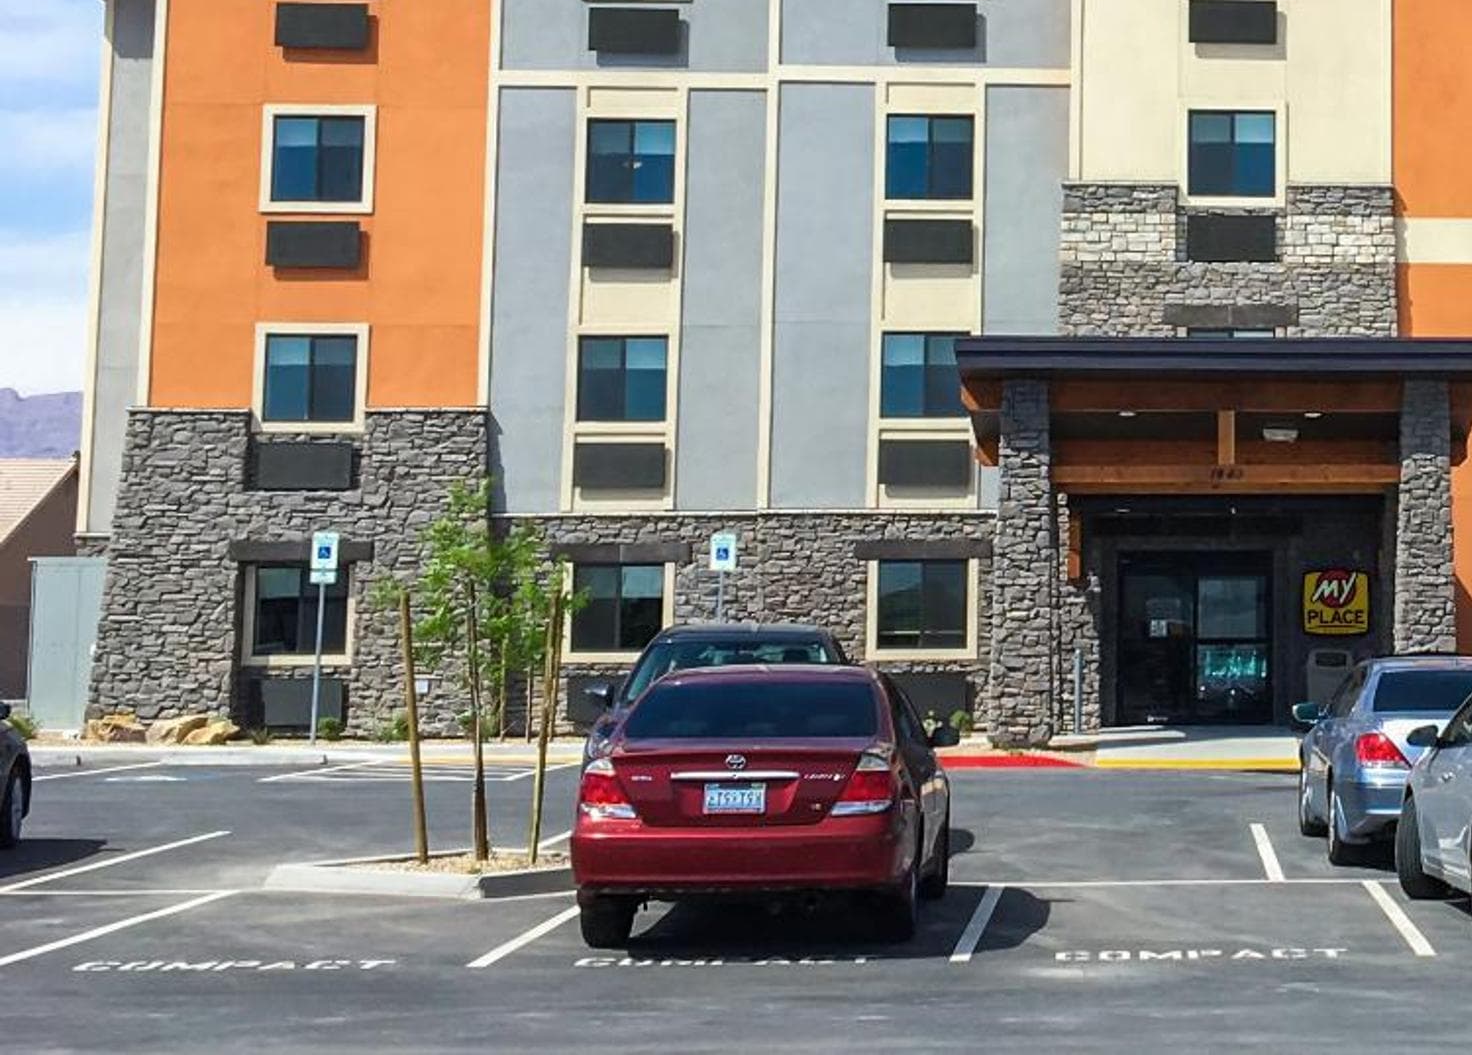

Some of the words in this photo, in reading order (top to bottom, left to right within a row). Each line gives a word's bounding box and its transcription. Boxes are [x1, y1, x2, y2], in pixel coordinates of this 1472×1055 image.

[1307, 609, 1365, 624] PLACE
[1054, 948, 1348, 961] COMPACT
[71, 960, 397, 971] COMPACT
